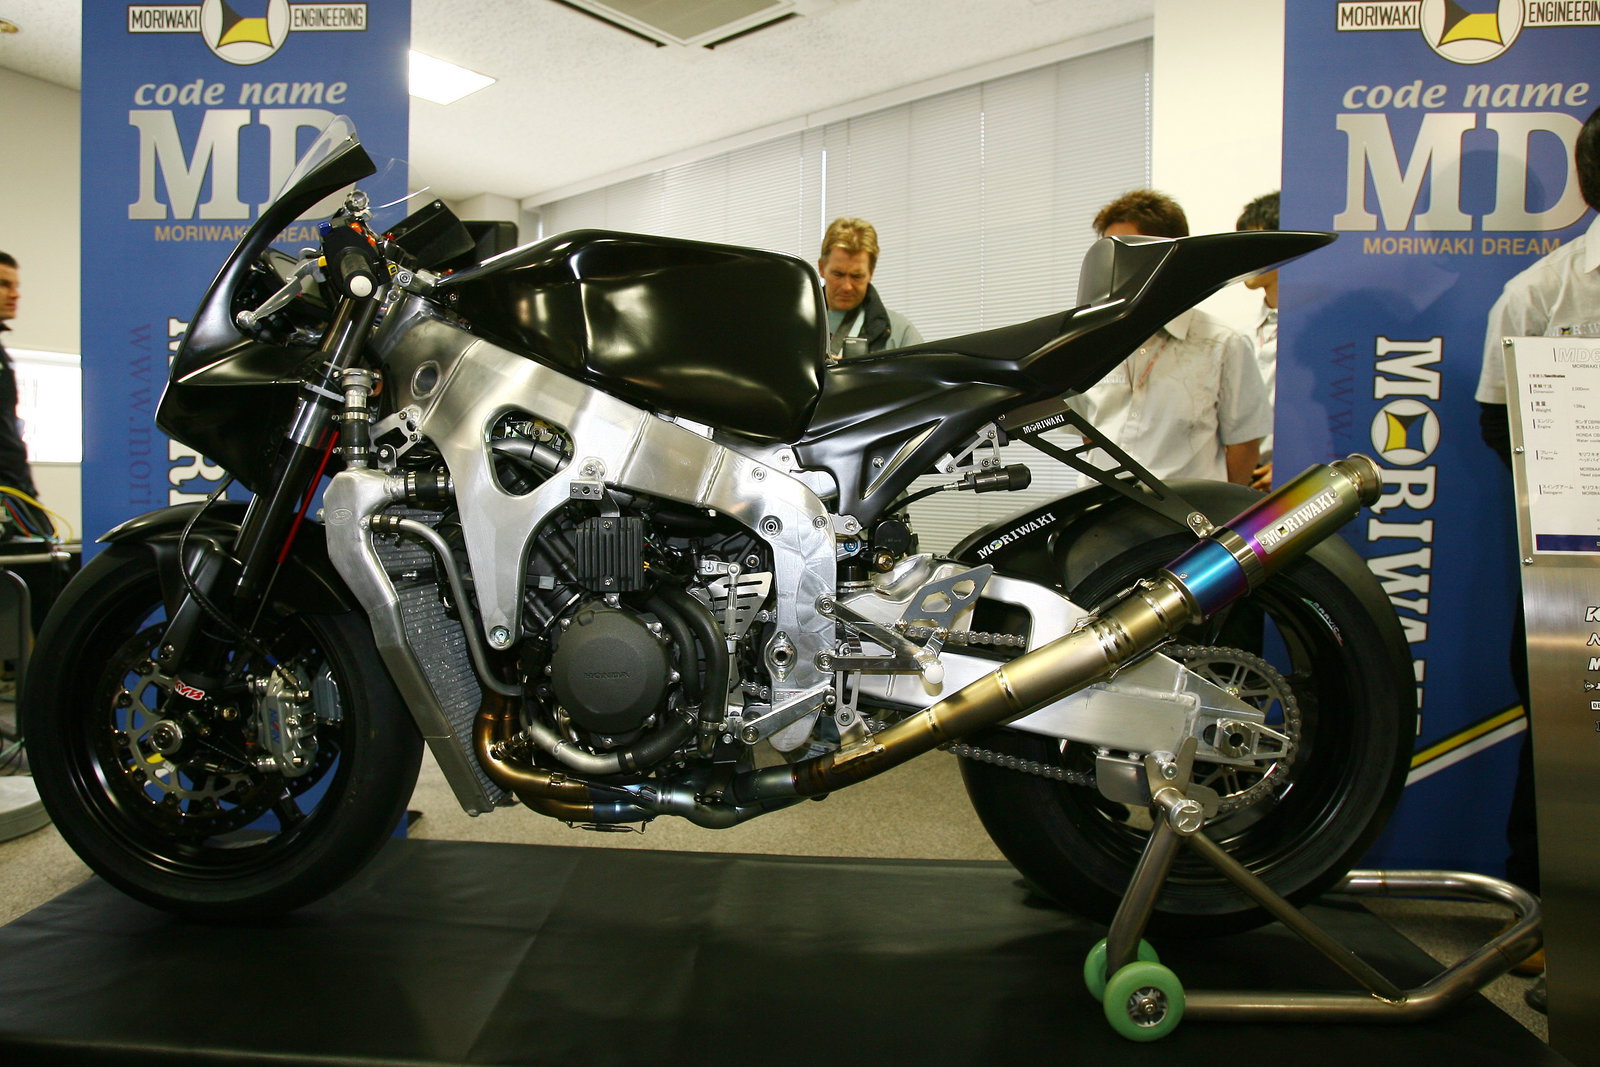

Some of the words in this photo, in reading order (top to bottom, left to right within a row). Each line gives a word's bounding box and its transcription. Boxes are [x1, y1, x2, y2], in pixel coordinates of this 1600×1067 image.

[131, 8, 198, 29] MORIWAKI
[293, 6, 364, 28] ENGINEERING
[1341, 4, 1417, 27] MORIWAKI
[134, 79, 225, 106] code
[239, 81, 348, 105] name
[1342, 80, 1448, 109] code
[1462, 82, 1590, 108] name
[1333, 112, 1592, 232] MD
[1362, 237, 1474, 256] MORIWAKI
[1481, 238, 1561, 256] DREAM
[1022, 414, 1065, 434] MORIWAKI
[1264, 491, 1337, 547] MORIWAKI
[976, 512, 1057, 560] MORIWAKI
